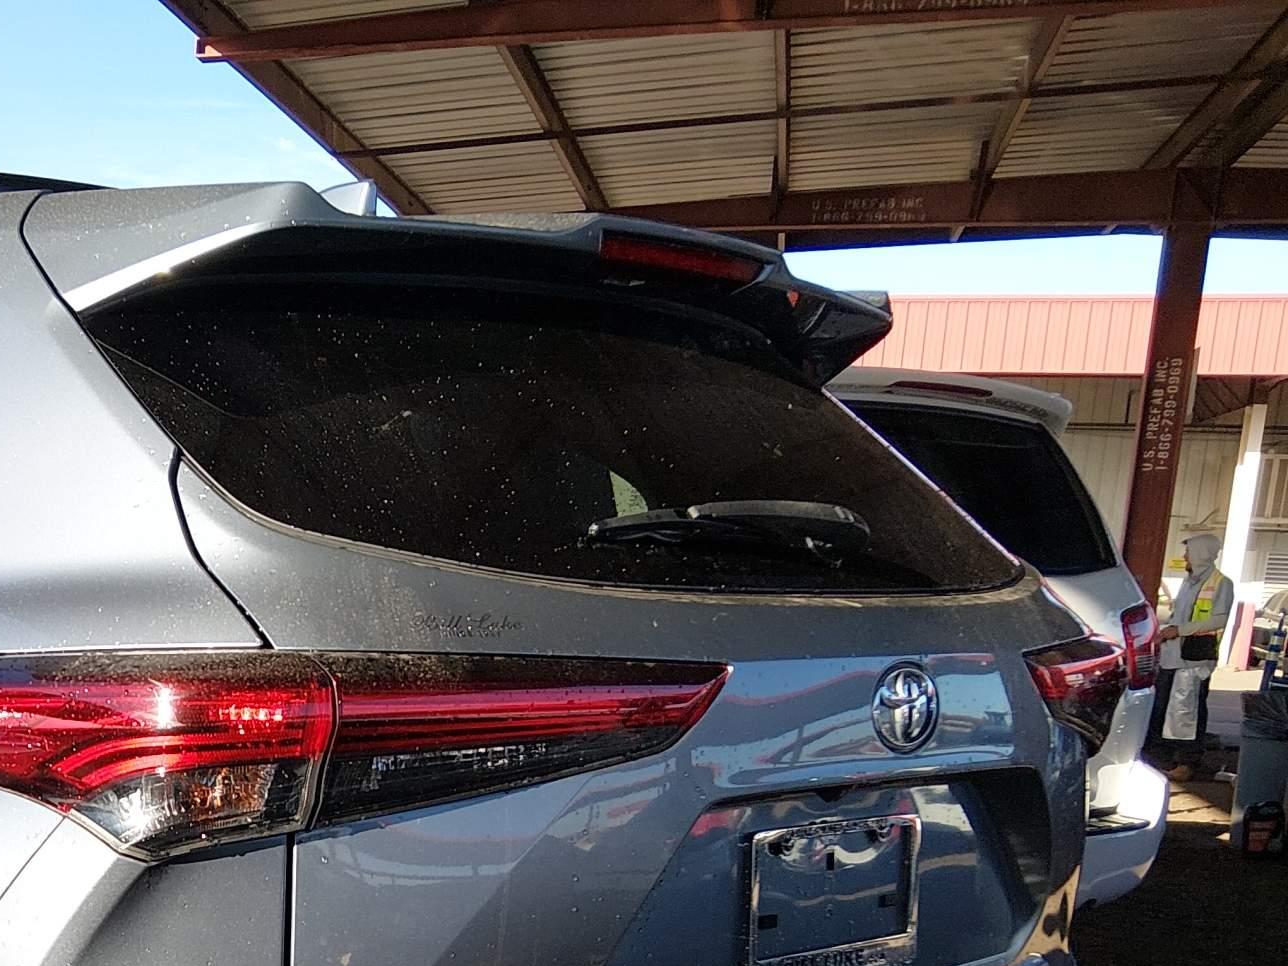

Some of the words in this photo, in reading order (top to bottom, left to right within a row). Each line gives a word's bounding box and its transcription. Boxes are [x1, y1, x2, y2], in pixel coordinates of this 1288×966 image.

[1155, 356, 1169, 382] INC.
[1145, 388, 1164, 440] PREFAB
[1155, 358, 1183, 471] 1-866-799-0969
[1142, 446, 1156, 472] U.S.
